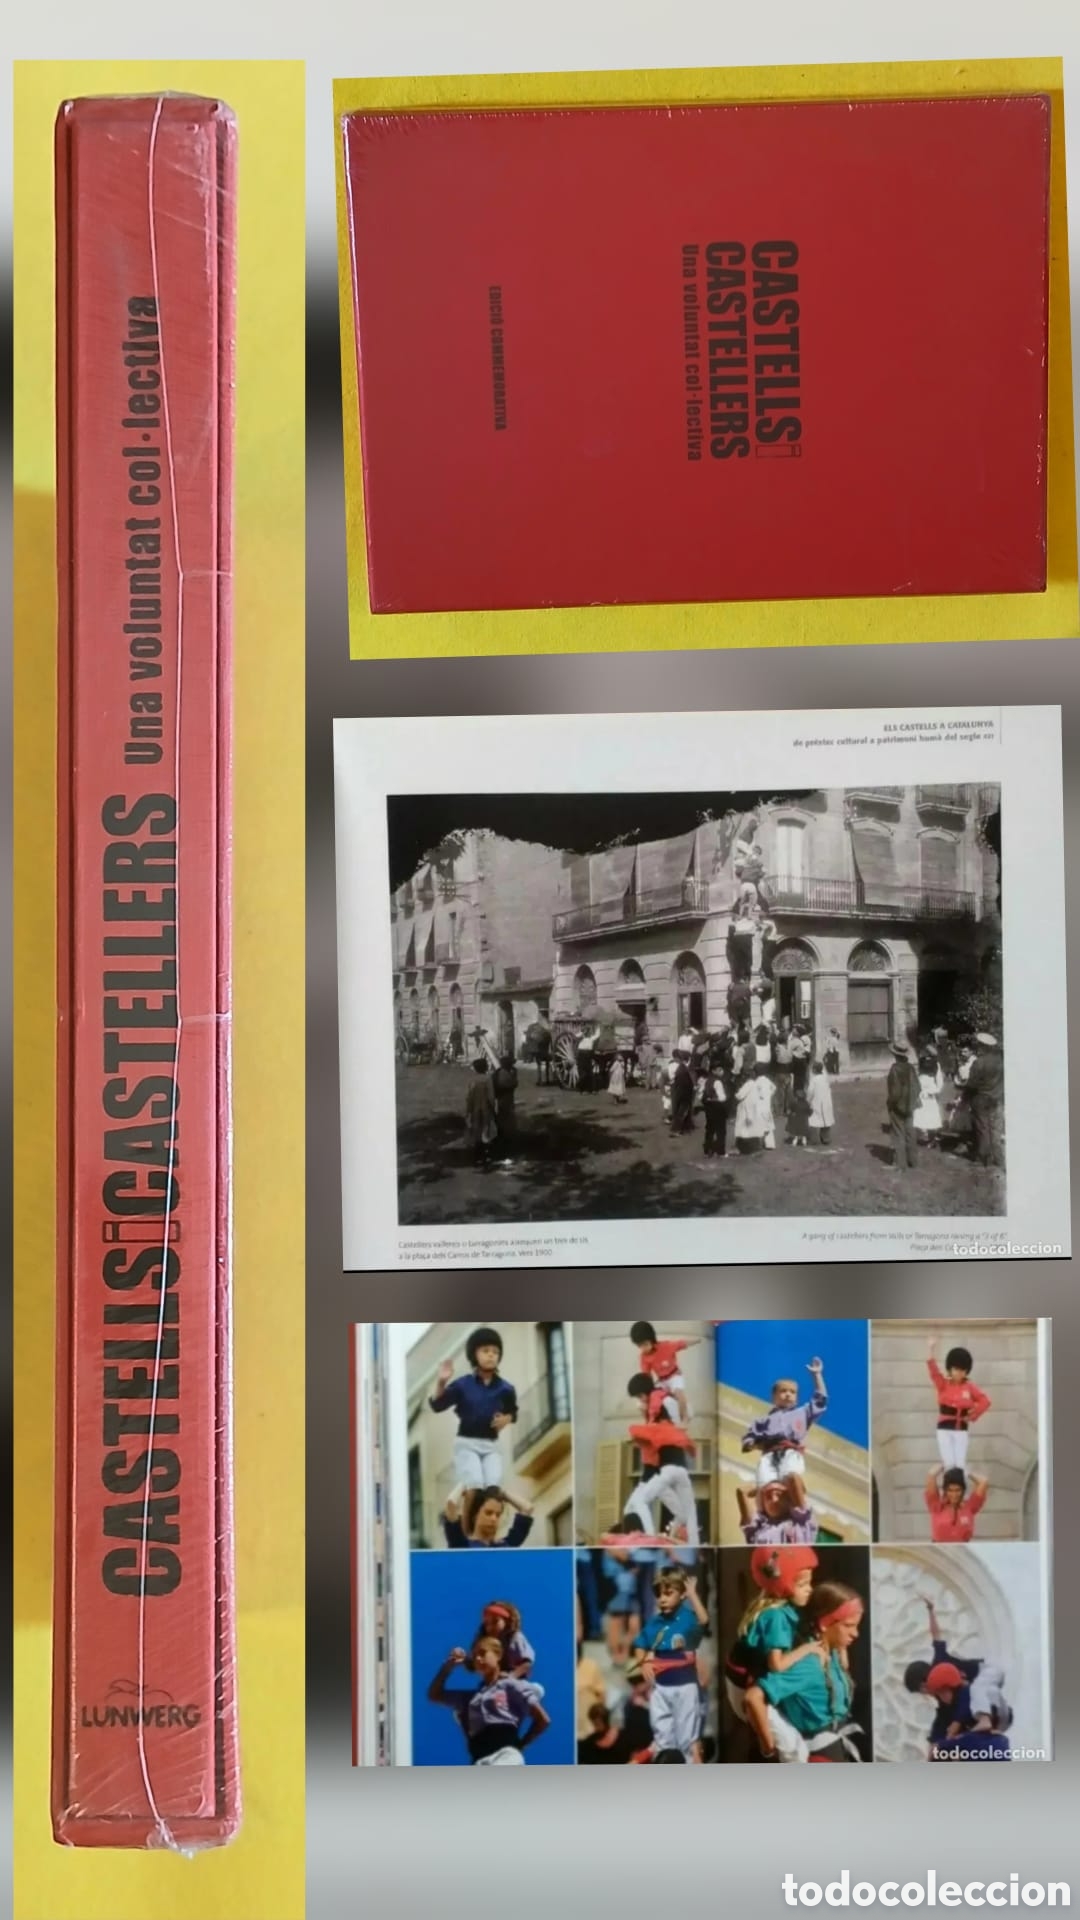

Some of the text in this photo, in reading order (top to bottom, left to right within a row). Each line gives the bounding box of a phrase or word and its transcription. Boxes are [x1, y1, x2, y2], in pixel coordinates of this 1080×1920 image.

[681, 244, 699, 278] Una
[683, 284, 700, 359] voluntat
[705, 241, 750, 460] CASTELLERS
[490, 327, 507, 431] COMMEMORATIVA
[122, 516, 163, 682] voluntat
[123, 692, 163, 766] Una
[837, 736, 868, 745] cultural
[877, 735, 917, 746] patrimoni
[944, 732, 957, 741] del
[960, 732, 981, 742] segle
[883, 724, 898, 732] ELS
[899, 722, 937, 732] CASTELLS
[947, 720, 994, 729] CATALUNYA
[81, 1703, 201, 1728] LUNWERG
